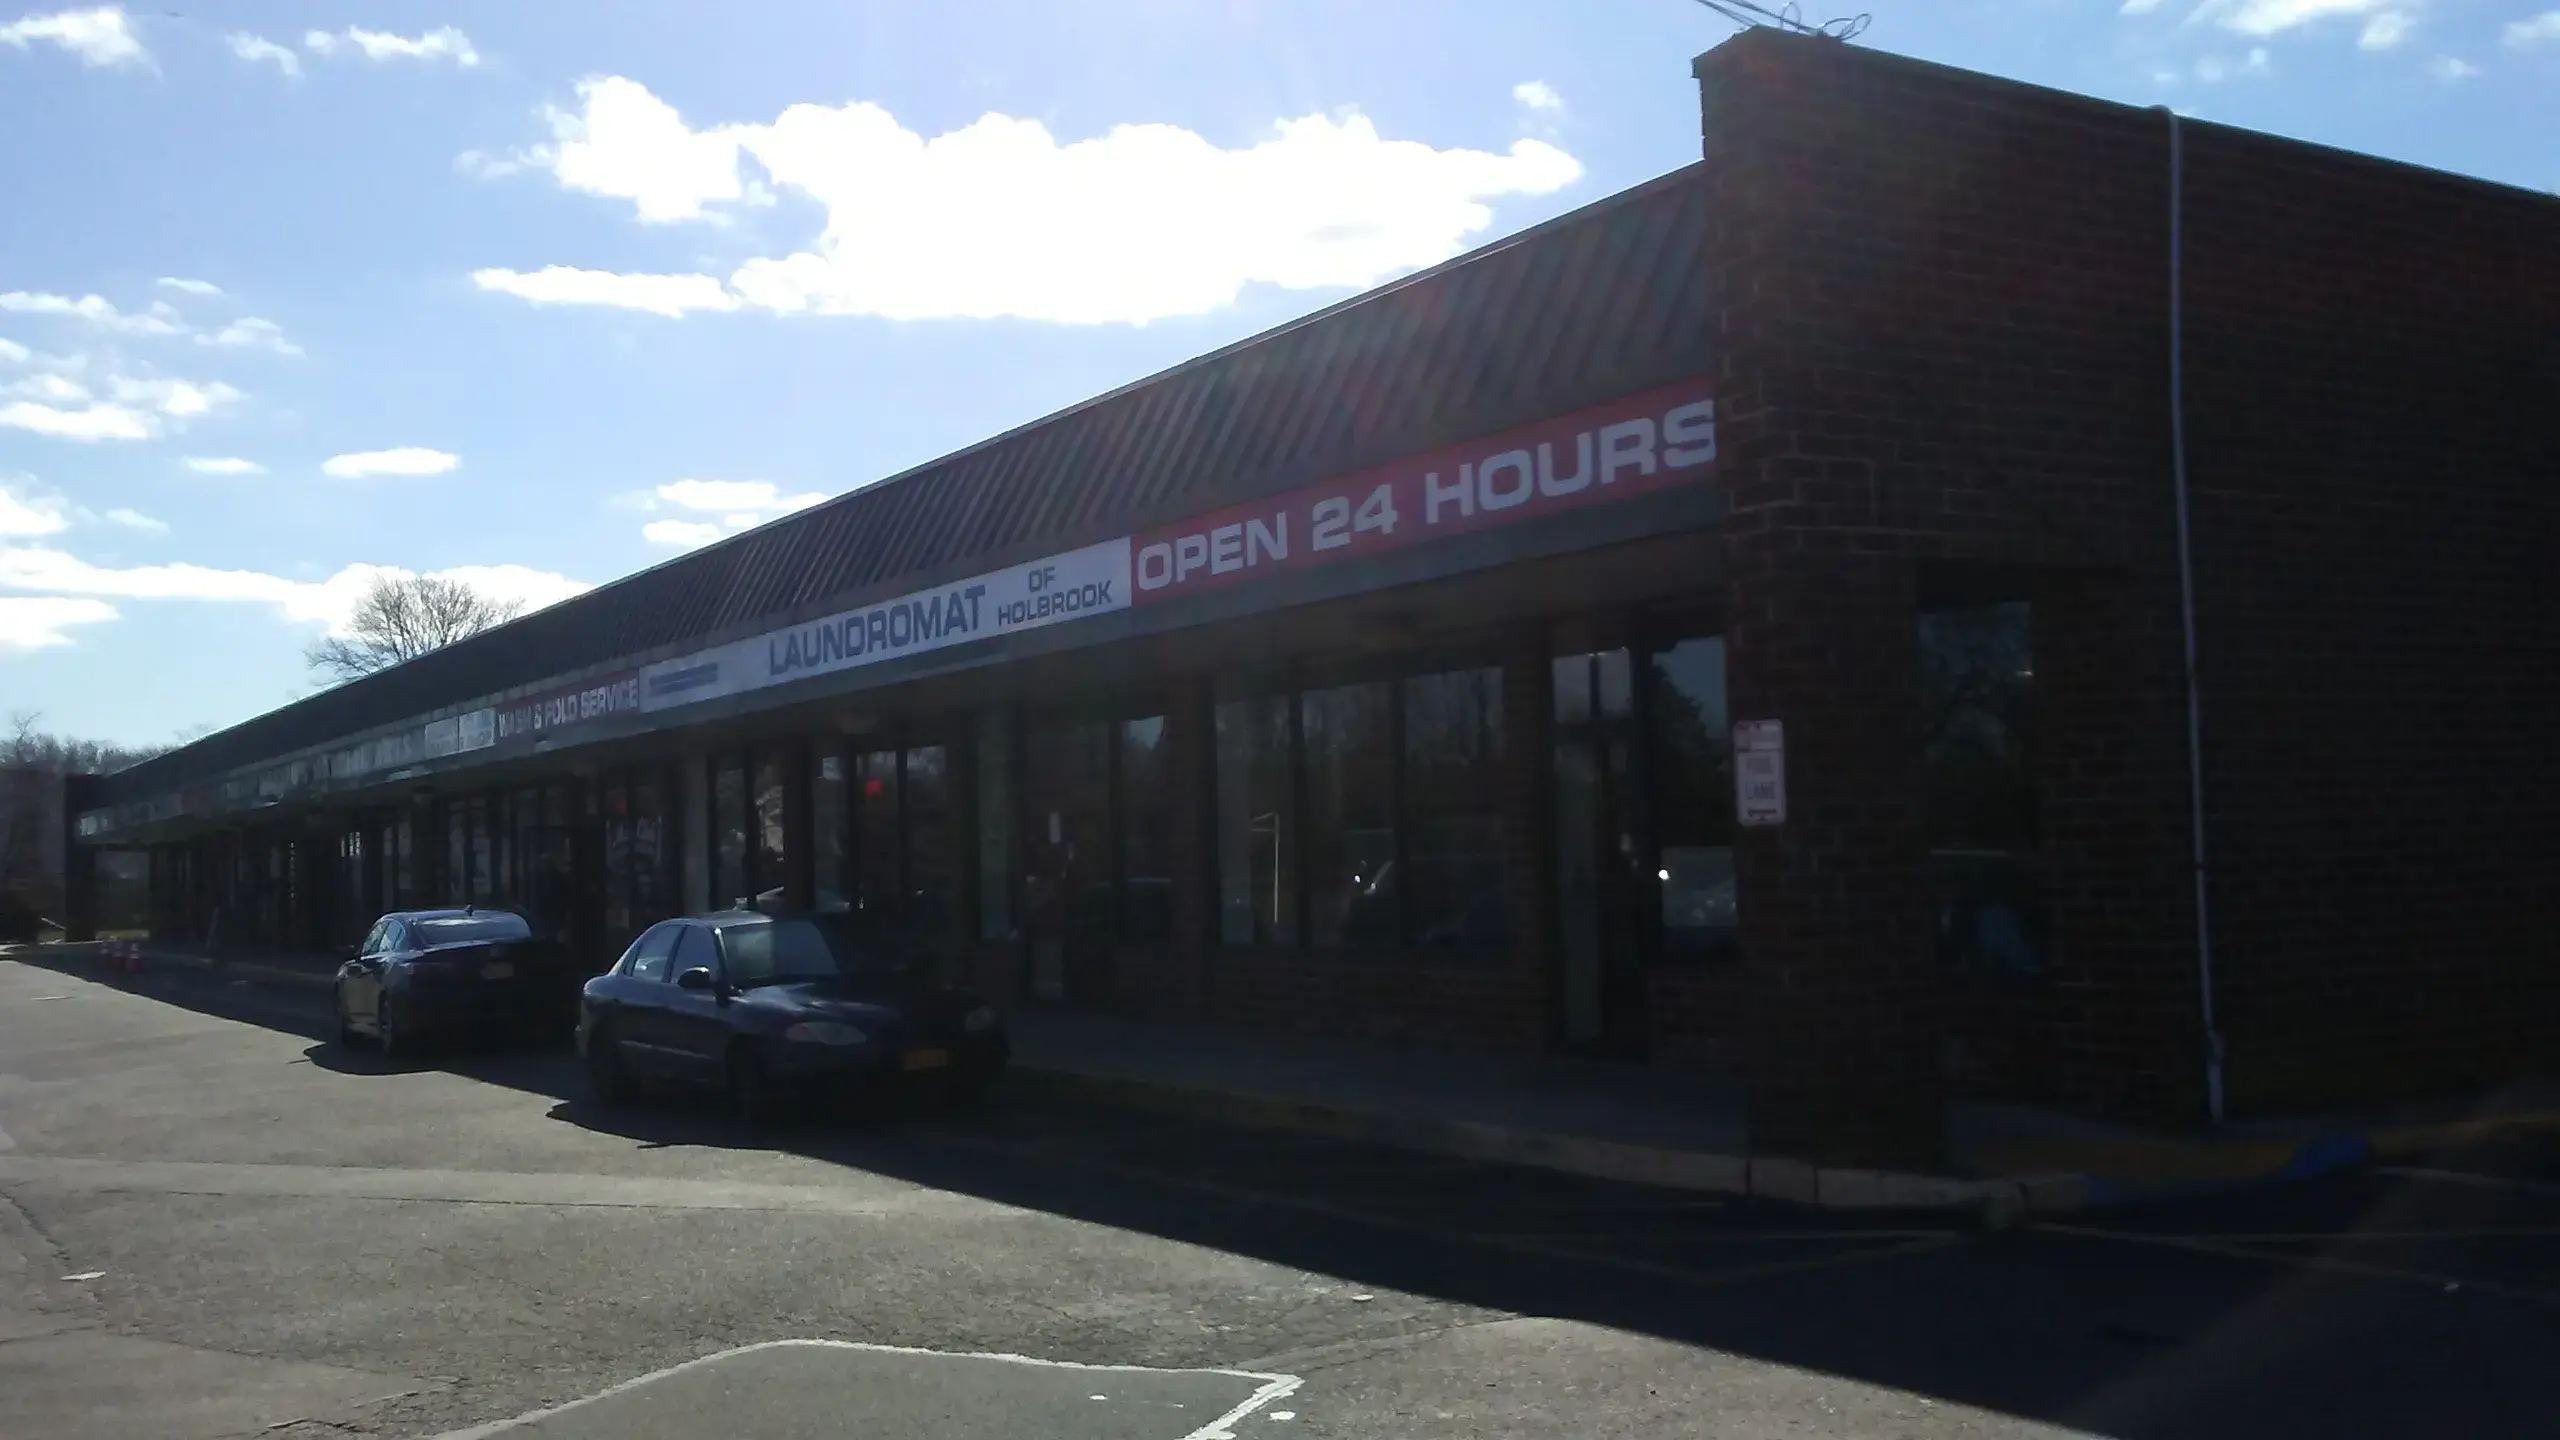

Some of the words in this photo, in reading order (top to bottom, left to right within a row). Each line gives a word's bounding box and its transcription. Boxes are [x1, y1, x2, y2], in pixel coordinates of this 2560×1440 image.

[1138, 511, 1288, 590] OPEN
[1312, 483, 1397, 551] 24
[1425, 398, 1717, 525] HOURS
[1028, 566, 1055, 592] OF
[997, 580, 1112, 626] HOLBROOK
[769, 584, 986, 676] LAUNDROMAT
[580, 678, 638, 719] SERVICE
